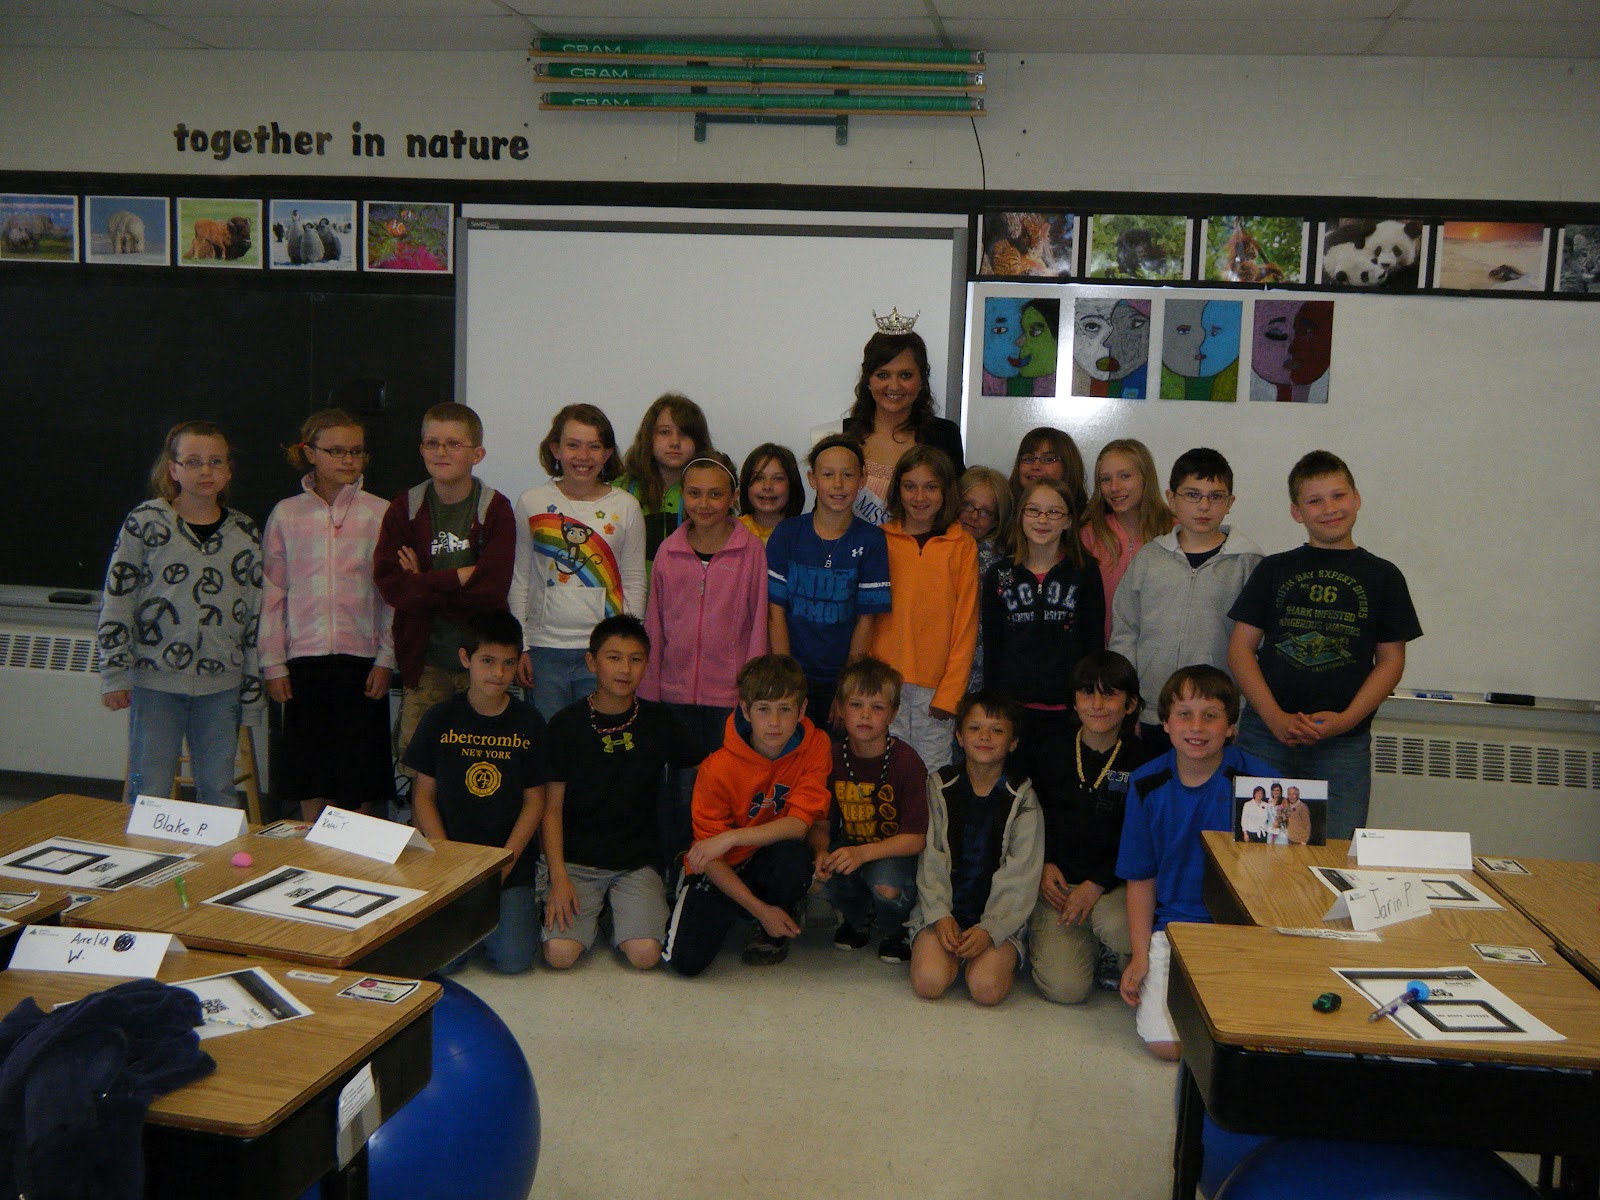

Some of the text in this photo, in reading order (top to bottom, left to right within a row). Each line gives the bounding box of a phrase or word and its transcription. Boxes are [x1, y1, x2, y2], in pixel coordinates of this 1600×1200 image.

[570, 68, 628, 78] CRAM
[173, 121, 529, 161] together in nature
[1295, 570, 1315, 582] BAY
[1318, 569, 1357, 586] EXPERT
[1352, 585, 1369, 619] DIVERS
[1309, 584, 1338, 603] 86
[1314, 609, 1356, 622] INFESTED
[440, 729, 531, 750] abercrombe
[461, 748, 511, 760] NEW YORK
[835, 780, 876, 802] EAT
[153, 813, 190, 835] Blake
[1369, 888, 1401, 919] Jarin
